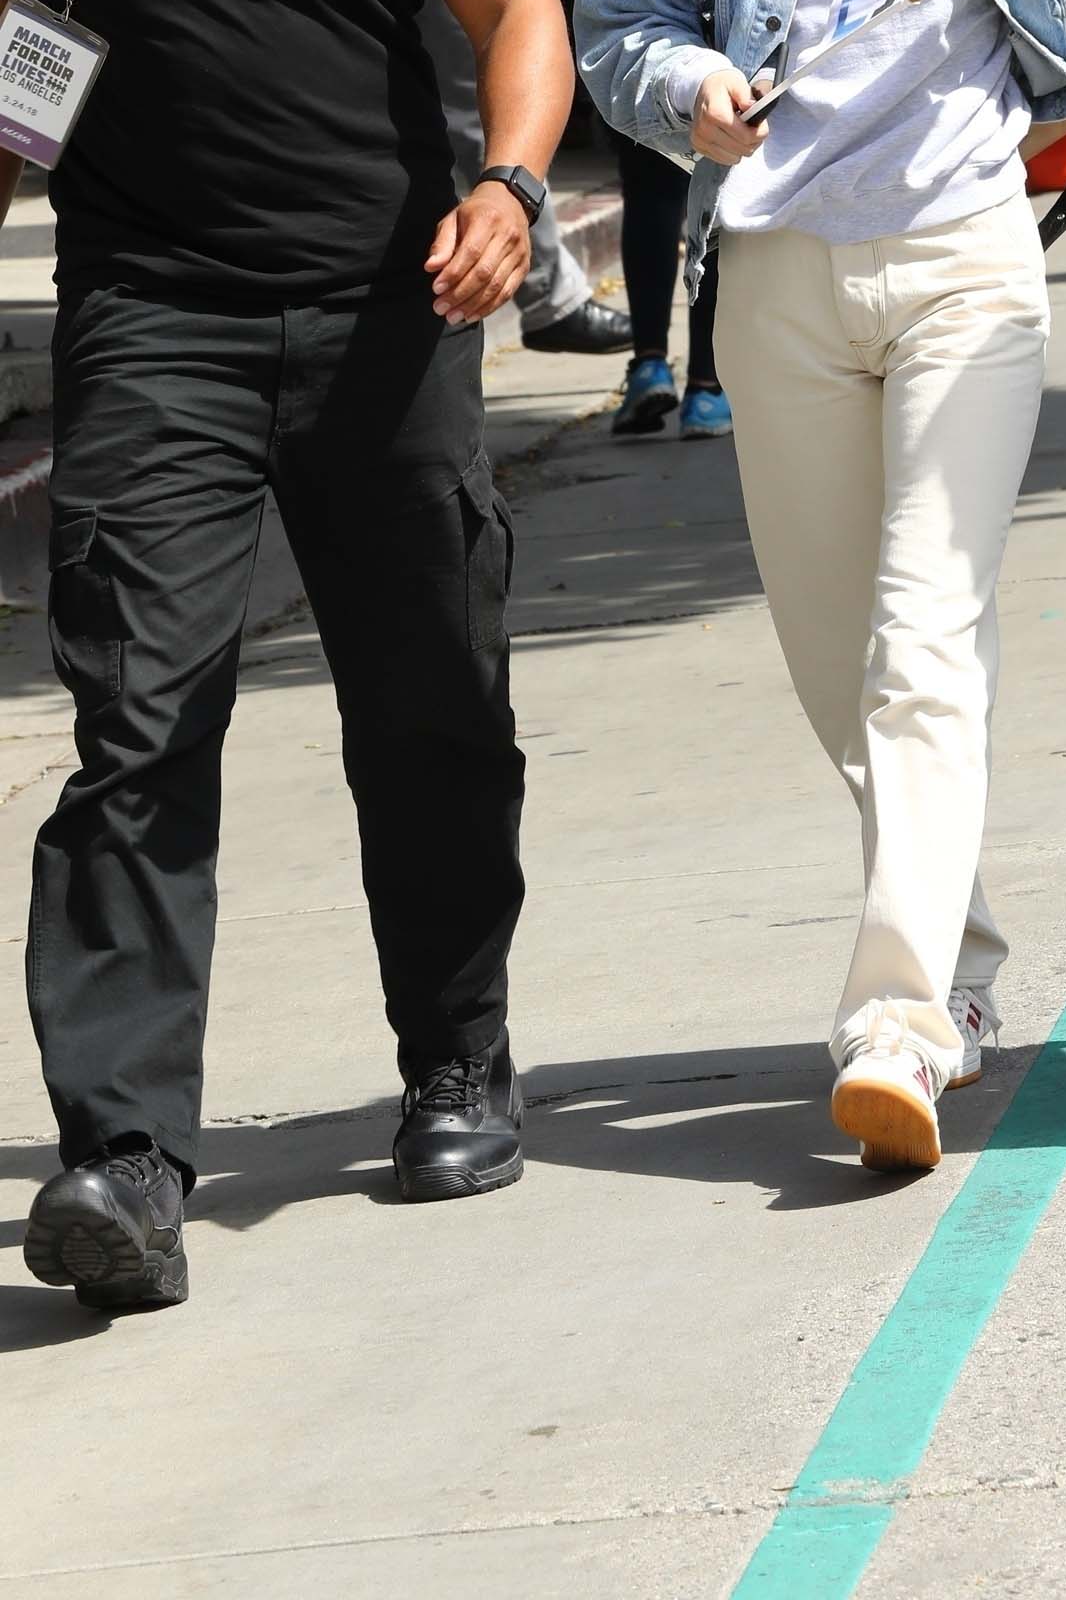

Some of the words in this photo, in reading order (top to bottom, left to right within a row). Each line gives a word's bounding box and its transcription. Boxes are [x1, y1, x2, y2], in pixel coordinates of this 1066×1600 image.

[8, 40, 42, 66] FOR
[40, 56, 74, 83] OUR
[14, 26, 72, 64] MARCH
[1, 54, 47, 87] LIVES
[3, 95, 38, 116] 3.24.18
[18, 78, 63, 107] ANGELES
